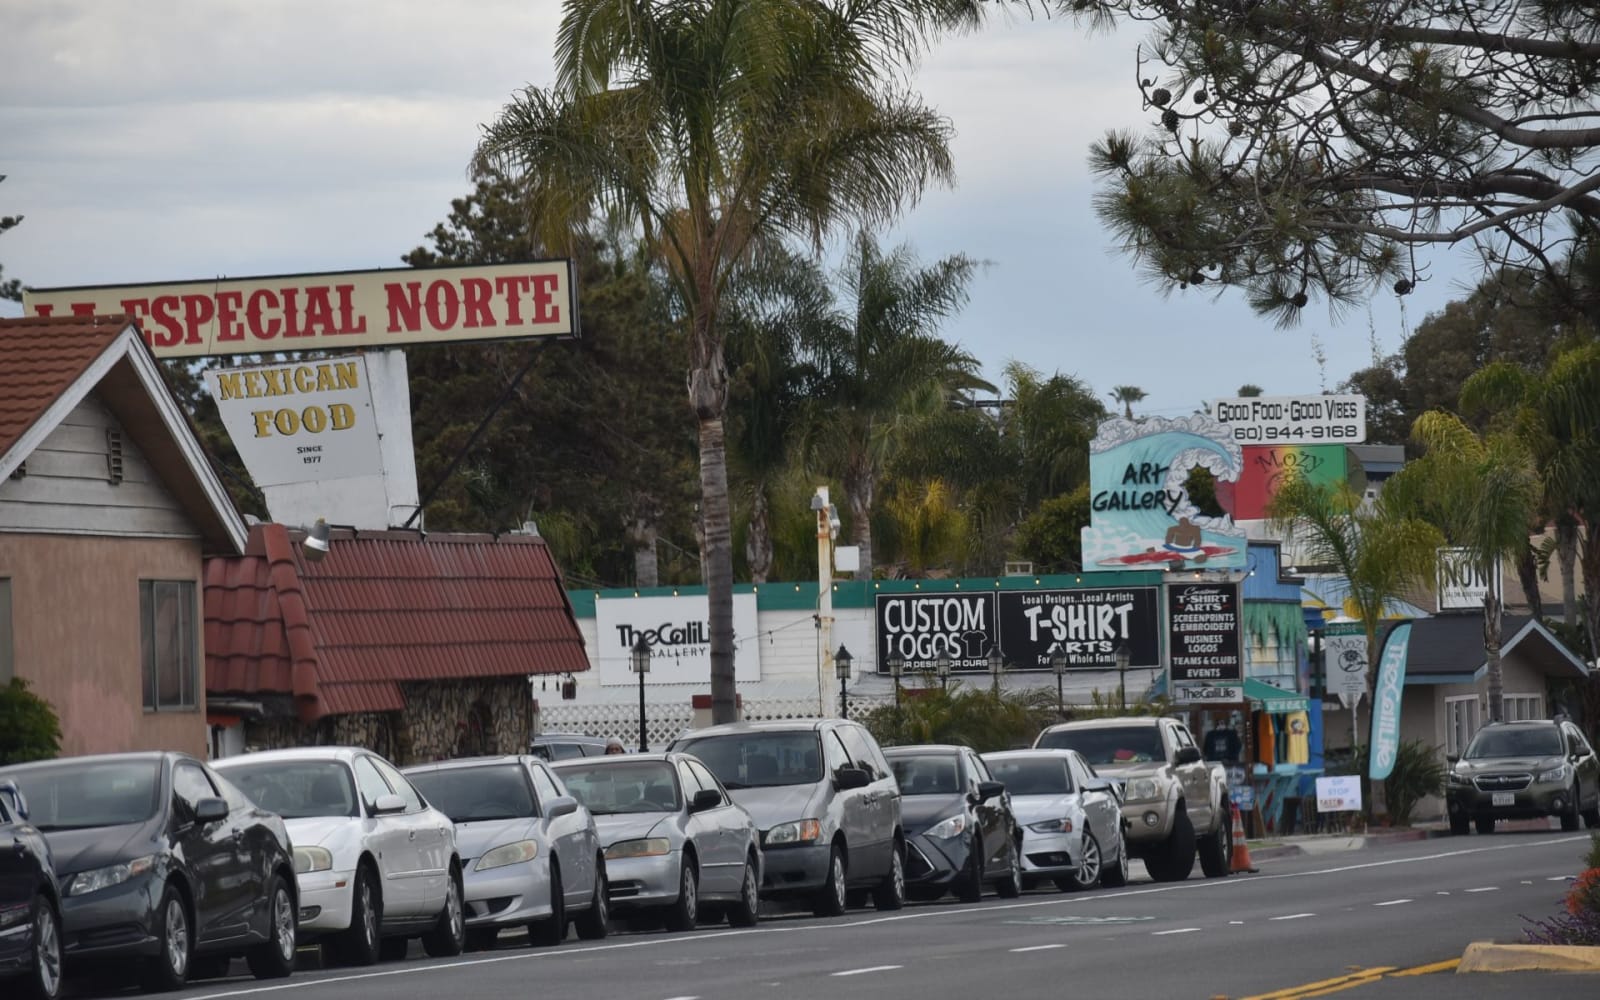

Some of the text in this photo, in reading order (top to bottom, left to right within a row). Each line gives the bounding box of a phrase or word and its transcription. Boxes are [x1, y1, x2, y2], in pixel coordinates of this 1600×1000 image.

[121, 274, 560, 347] ESPECIAL NORTE
[217, 361, 359, 400] MEXICAN
[251, 403, 356, 438] FOOD
[1234, 425, 1358, 441] 60) 944-9168
[297, 445, 323, 454] SINCE
[303, 456, 321, 464] 1977
[1122, 462, 1170, 486] ART
[1022, 594, 1043, 605] Local
[1105, 592, 1134, 602] Artists
[1176, 594, 1230, 604] T-SHIRT
[1184, 603, 1222, 612] ARTS
[885, 598, 986, 633] CUSTOM
[1173, 613, 1235, 623] SCREENPRINTS
[1023, 602, 1134, 642] T-SHIRT
[1173, 622, 1236, 632] & EMBROIDERY
[616, 621, 711, 647] TheCaliLi
[1184, 634, 1223, 644] BUSINESS
[885, 632, 962, 660] LOGOS
[1047, 640, 1113, 654] ARTS
[1188, 644, 1218, 653] LOGOS
[649, 647, 706, 658] GALLERY
[913, 660, 937, 668] DESI
[962, 659, 988, 667] OURS
[1038, 655, 1049, 665] For
[1069, 654, 1094, 664] Whole
[1095, 653, 1117, 663] Famil
[1173, 656, 1237, 665] TEAMS & CLUBS
[1187, 668, 1221, 678] EVENTS
